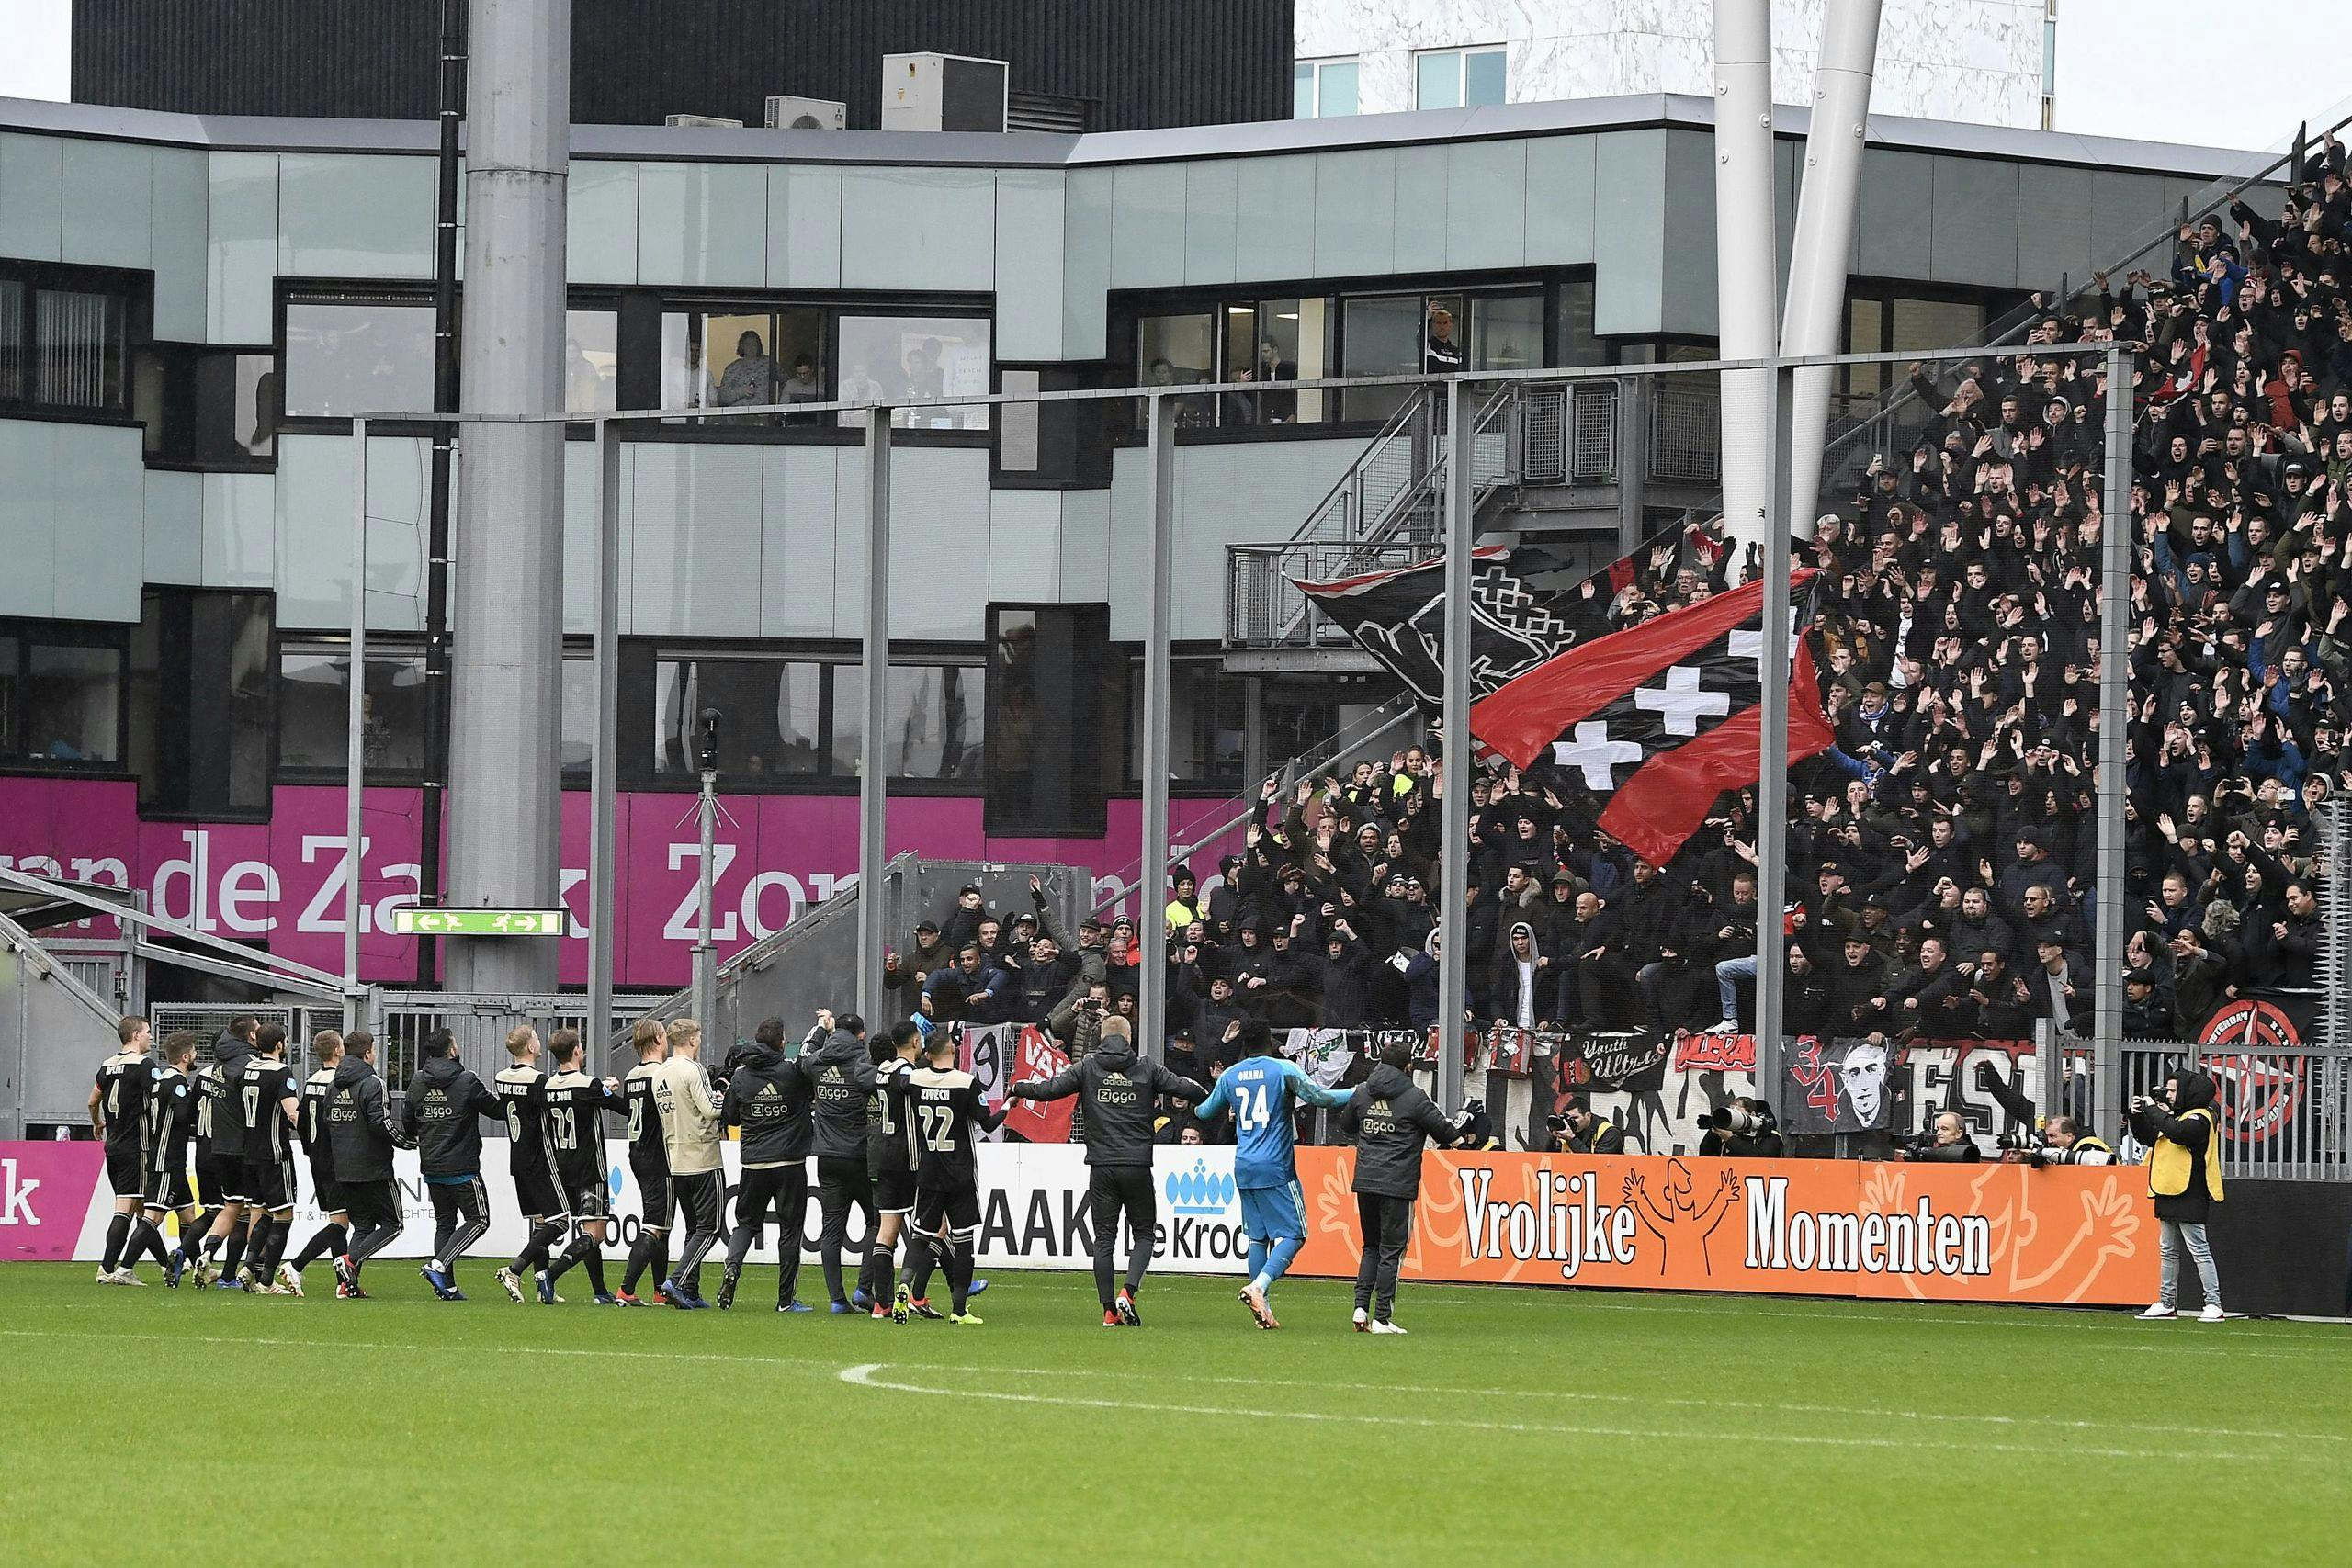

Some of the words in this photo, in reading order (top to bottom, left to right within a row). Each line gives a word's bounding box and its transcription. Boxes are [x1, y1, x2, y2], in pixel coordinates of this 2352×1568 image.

[149, 829, 279, 933] de
[1582, 1036, 1629, 1059] Youth
[820, 1075, 845, 1085] adidas
[1102, 1077, 1133, 1087] adidas
[107, 1078, 119, 1120] 4
[424, 1094, 448, 1102] adidas
[754, 1094, 783, 1102] adidas
[817, 1085, 849, 1100] Ziggo
[1097, 1088, 1136, 1103] Ziggo
[242, 1085, 260, 1128] 17
[422, 1105, 454, 1118] Ziggo
[751, 1103, 788, 1117] Ziggo
[1235, 1084, 1270, 1131] 24
[1366, 1108, 1393, 1118] adidas
[506, 1100, 521, 1143] 6
[550, 1106, 578, 1150] 21
[918, 1105, 955, 1152] 22
[1363, 1118, 1396, 1134] Ziggo
[1459, 1168, 1637, 1279] Vrolijke
[1744, 1176, 1991, 1276] Momenten
[1173, 1217, 1251, 1260] Kroo
